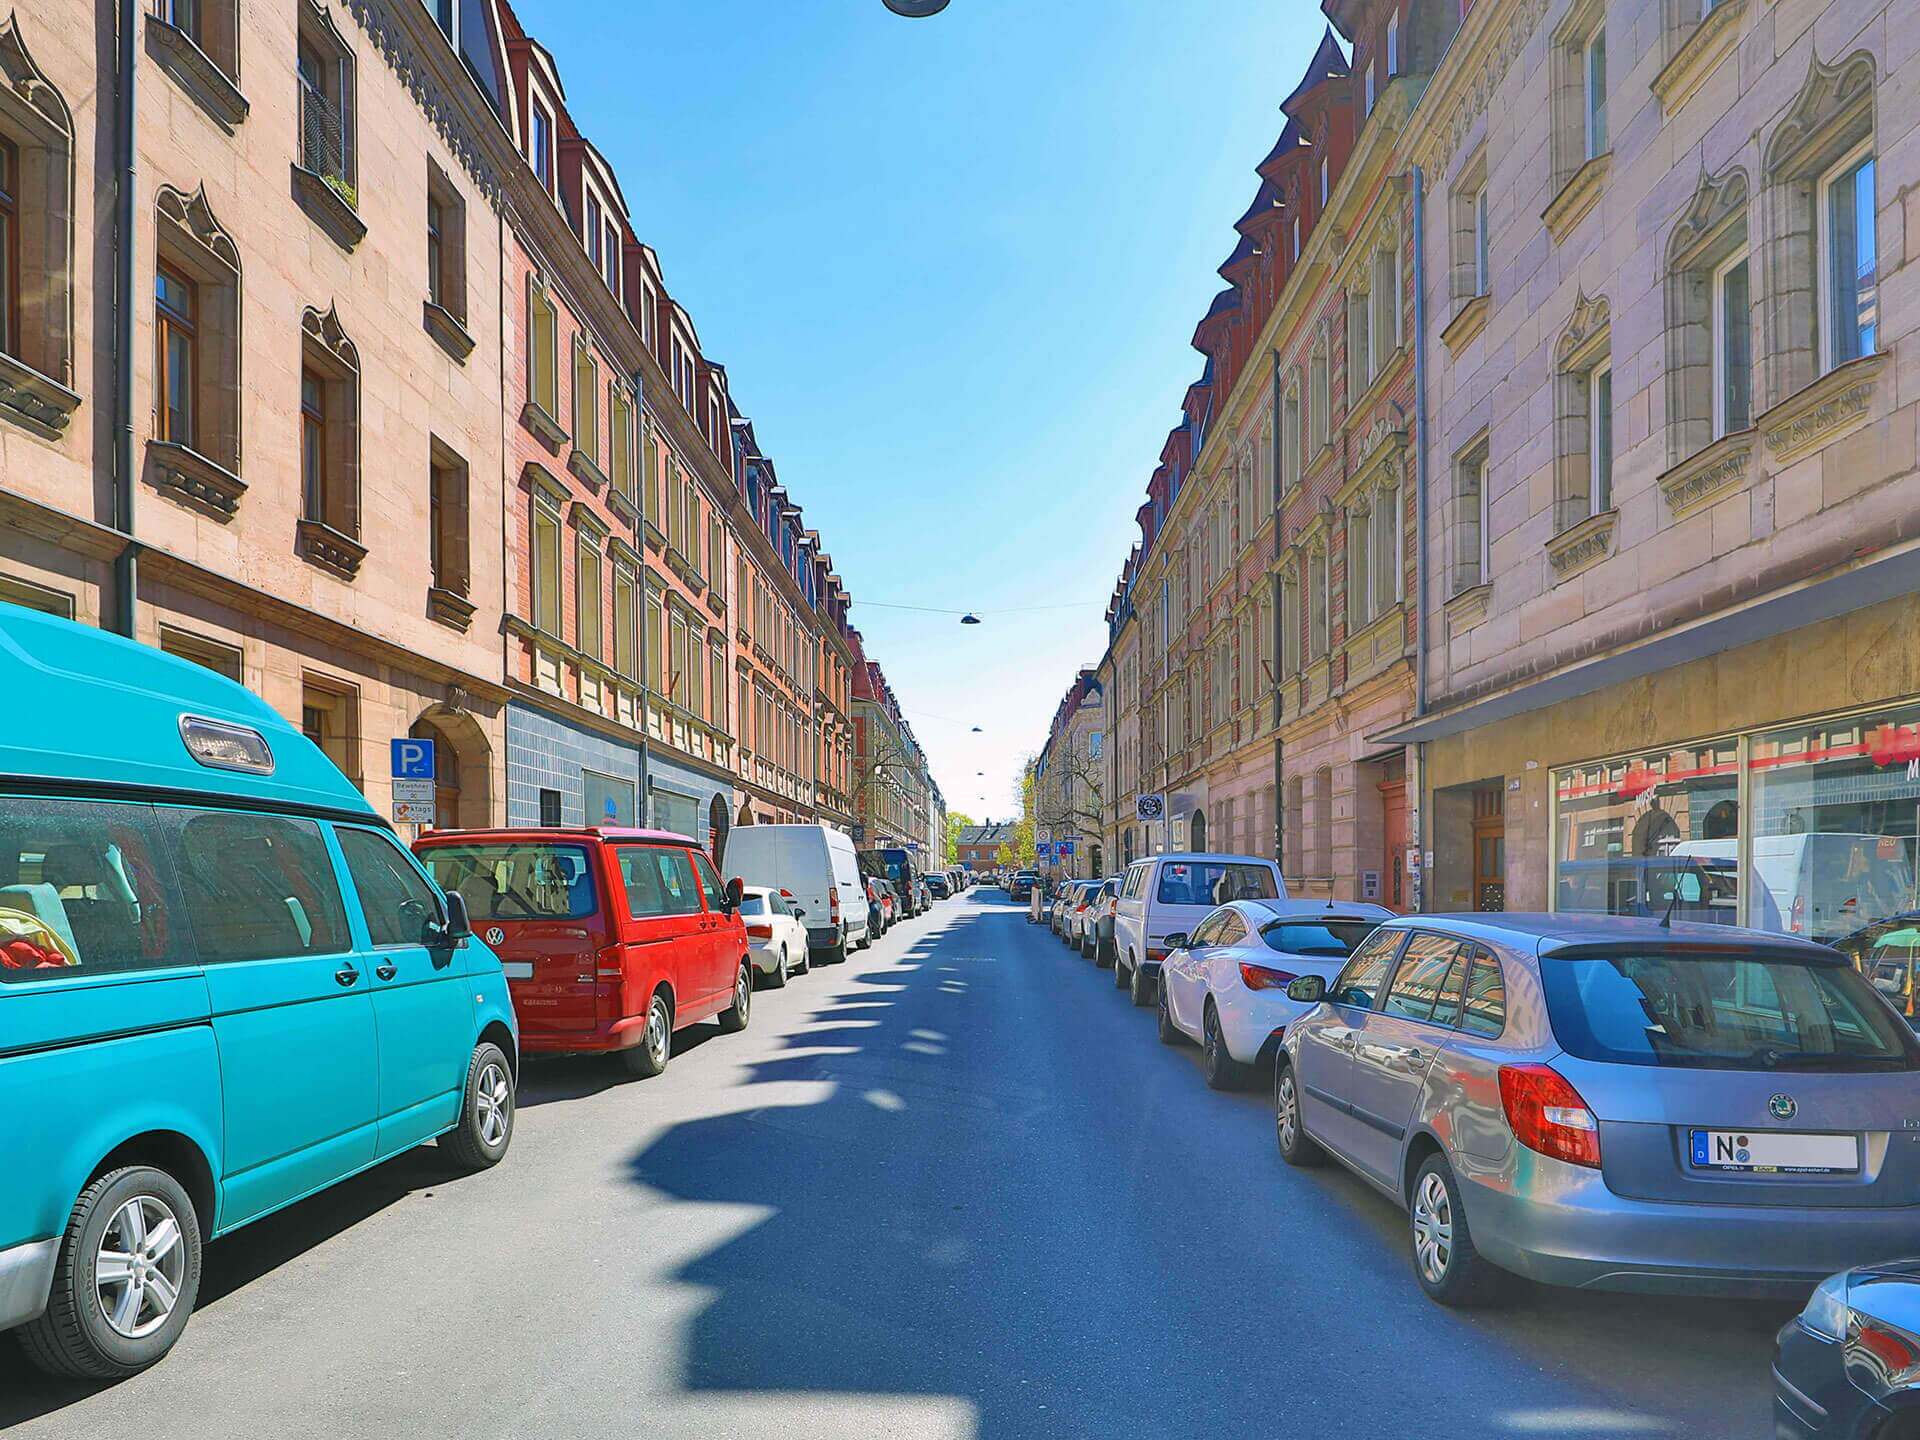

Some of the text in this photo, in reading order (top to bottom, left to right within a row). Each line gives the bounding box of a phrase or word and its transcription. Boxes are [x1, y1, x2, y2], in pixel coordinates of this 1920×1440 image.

[401, 744, 424, 774] P
[1697, 1151, 1705, 1159] D
[1716, 1135, 1734, 1161] N
